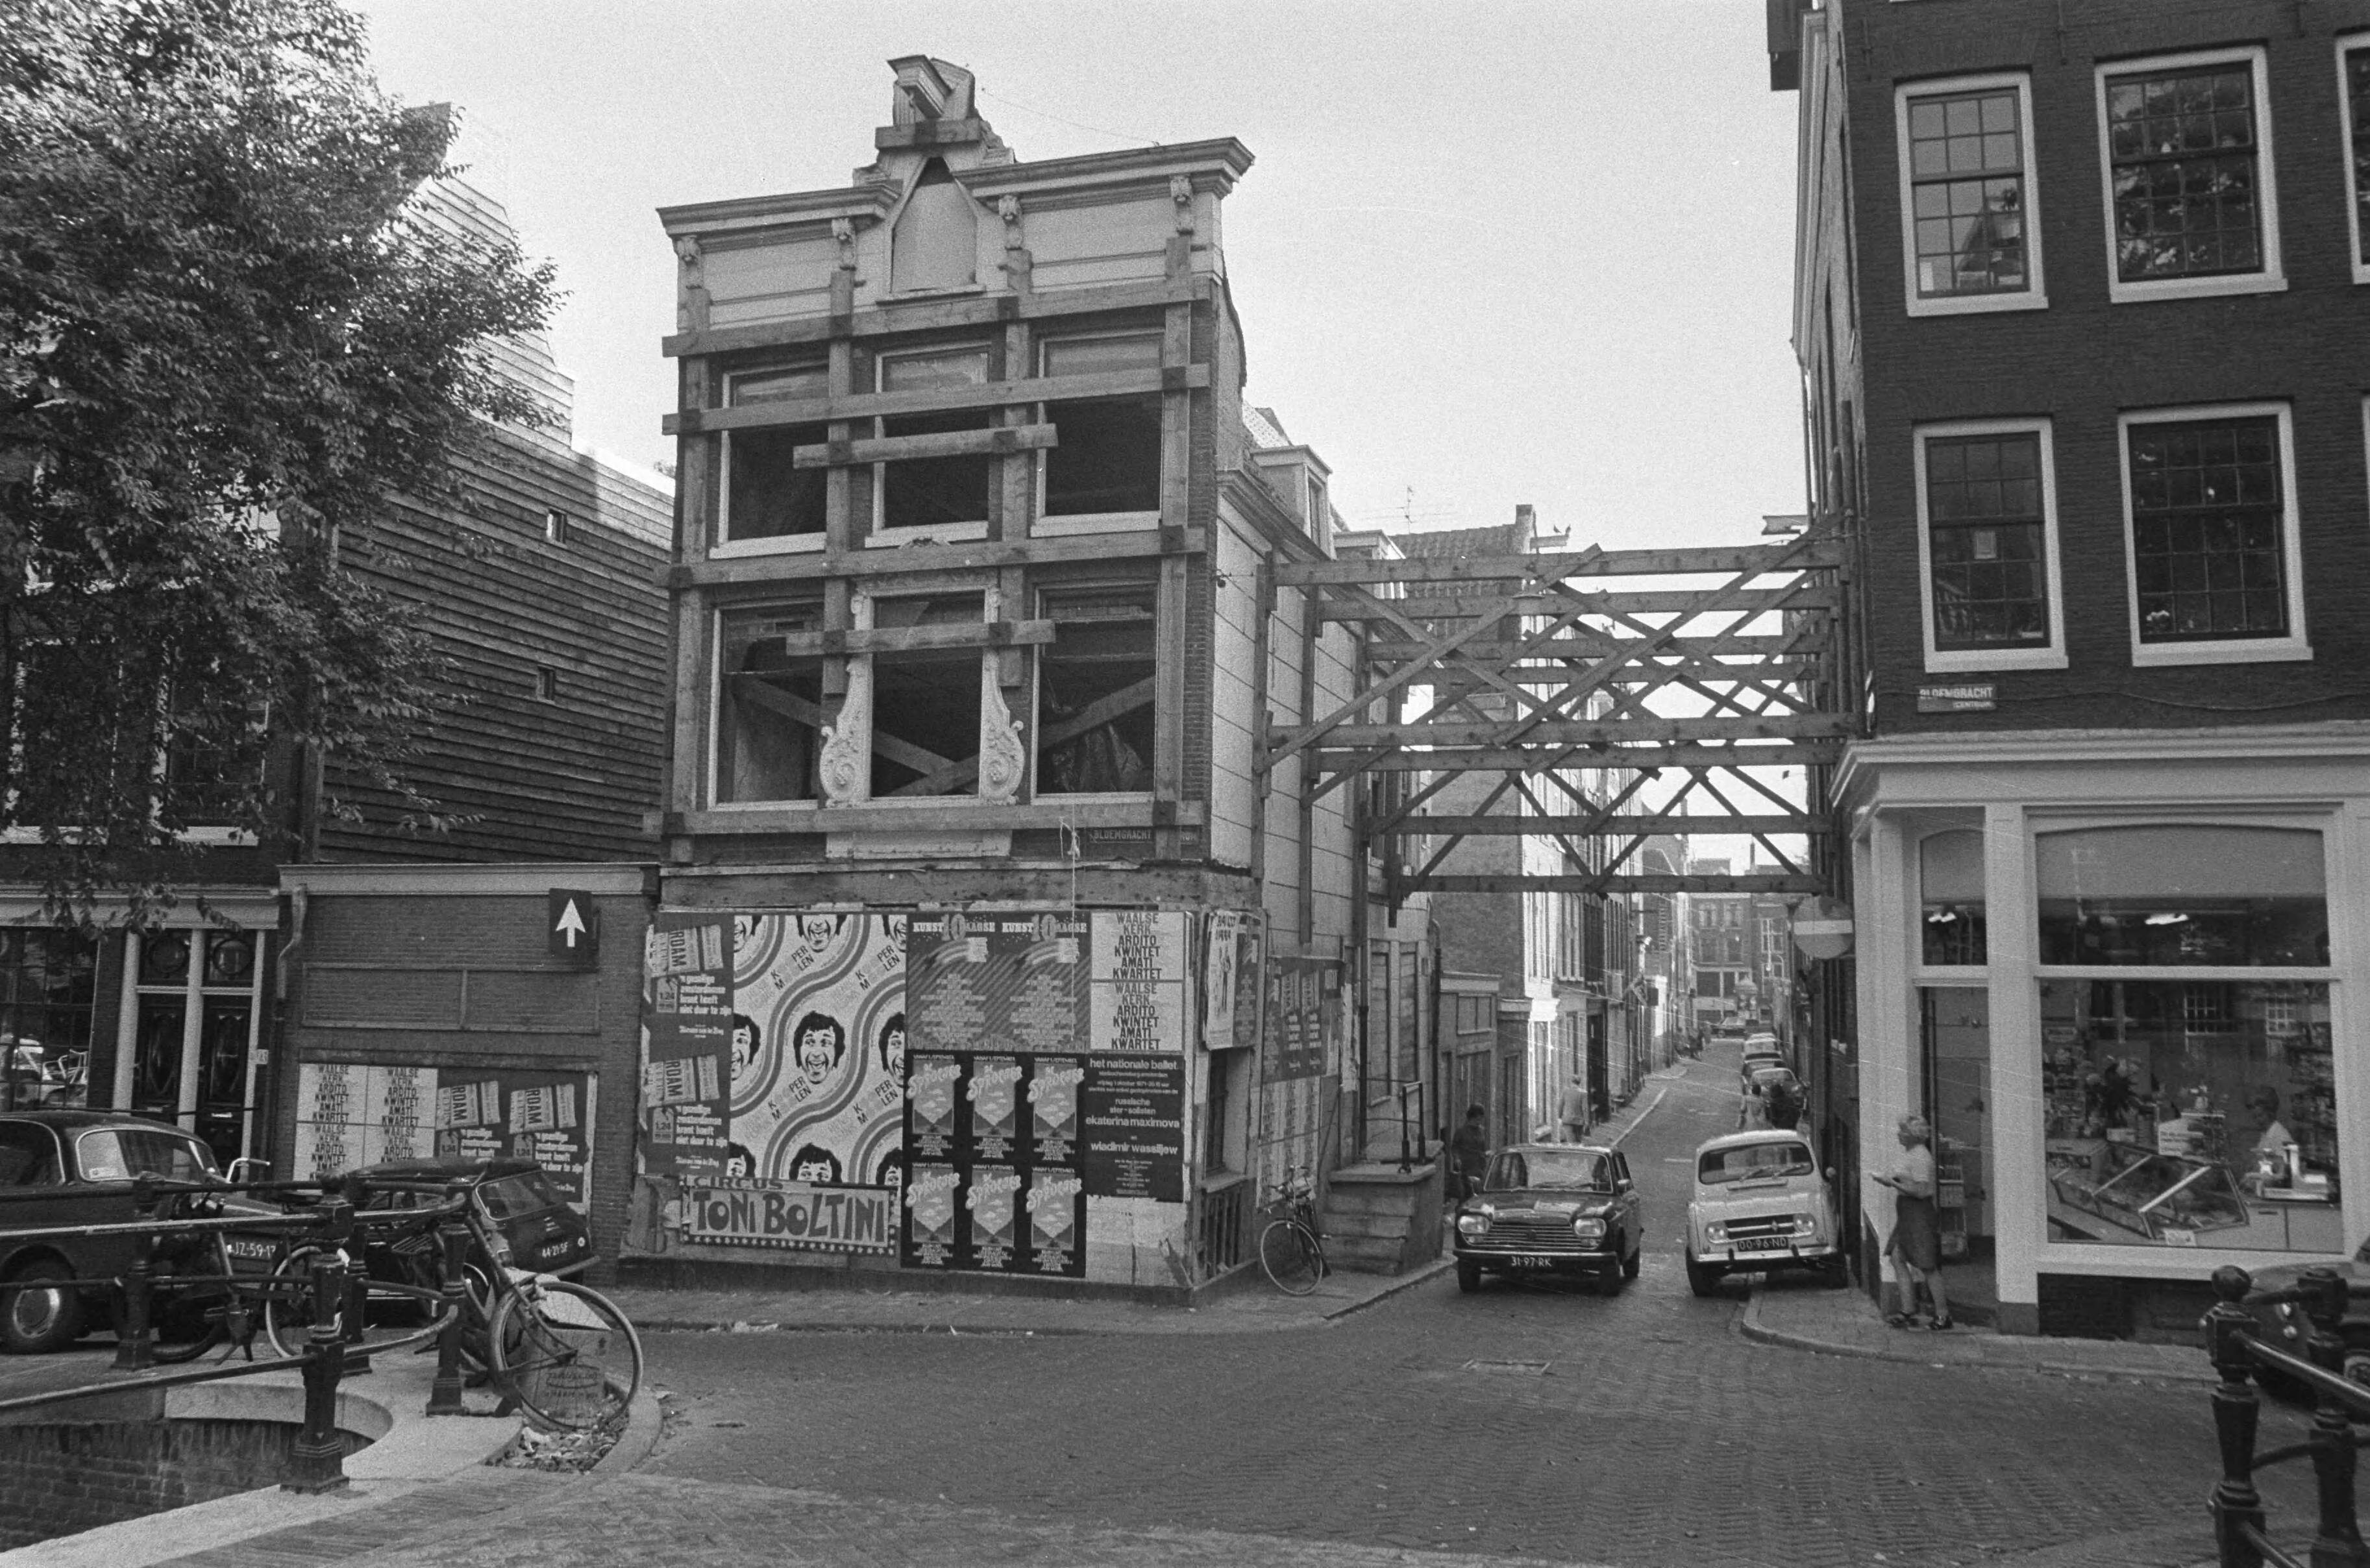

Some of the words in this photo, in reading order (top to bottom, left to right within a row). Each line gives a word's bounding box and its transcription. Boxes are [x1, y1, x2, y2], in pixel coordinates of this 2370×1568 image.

[1116, 913, 1159, 925] WAALSE
[1124, 924, 1151, 935] KERK
[1118, 935, 1156, 946] ARDITO
[1115, 946, 1161, 957] KWINTET
[1121, 957, 1152, 968] AMATI
[1113, 968, 1162, 979] KWARTET
[1115, 983, 1157, 994] WAALSE
[1122, 994, 1150, 1005] KERK
[1117, 1005, 1155, 1016] ARDITO
[1113, 1016, 1159, 1027] KWINTET
[1120, 1027, 1151, 1038] AMATI
[1111, 1038, 1161, 1049] KWARTET
[1090, 1058, 1105, 1068] het
[1107, 1059, 1150, 1069] nationale
[319, 1083, 347, 1094] ARDITO
[388, 1087, 417, 1097] ARDITO
[320, 1103, 343, 1112] AMATI
[389, 1107, 413, 1116] AMATI
[312, 1112, 349, 1123] KWARTET
[382, 1116, 419, 1127] KWARTET
[1085, 1116, 1129, 1126] ekaterina
[1130, 1118, 1180, 1128] maximova
[315, 1144, 344, 1153] ARDITO
[1091, 1141, 1130, 1151] wladimir
[384, 1147, 414, 1157] ARDITO
[694, 1176, 784, 1191] CIRCUS
[693, 1189, 756, 1233] TONI
[762, 1192, 885, 1243] BOLTINI
